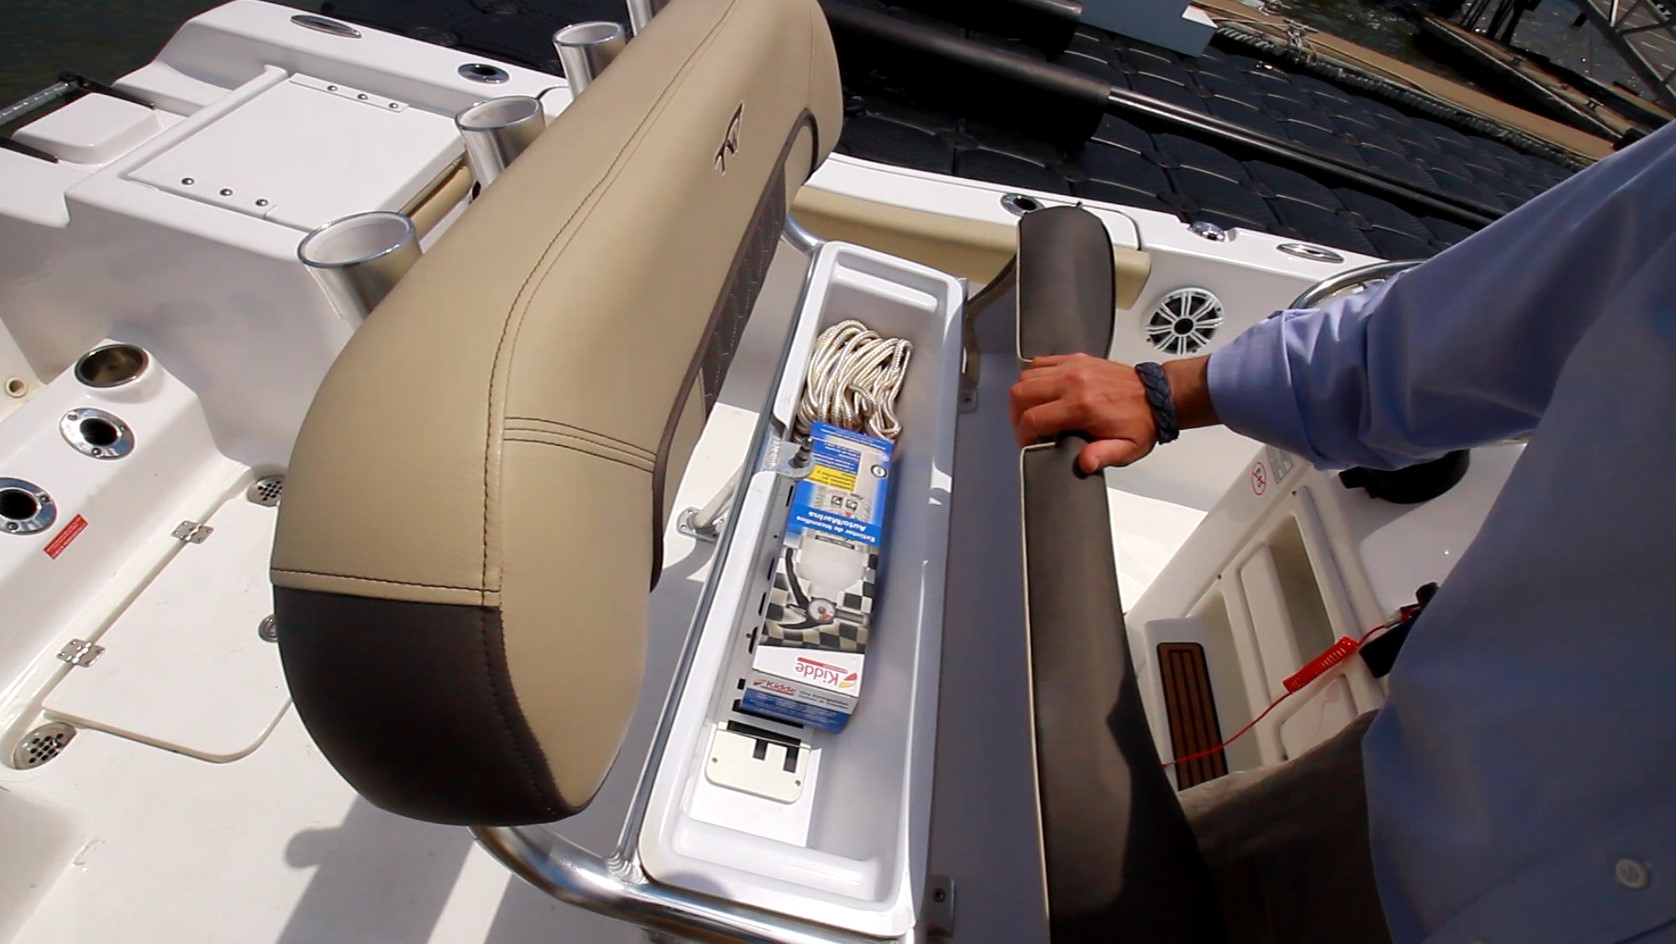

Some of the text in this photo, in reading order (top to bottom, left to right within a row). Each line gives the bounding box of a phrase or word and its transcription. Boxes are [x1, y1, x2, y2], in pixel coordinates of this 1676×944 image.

[796, 515, 833, 531] Incendios
[808, 511, 867, 532] Auto/Marina
[833, 525, 844, 533] de
[844, 529, 876, 543] Extintor
[795, 662, 840, 686] Kidde
[766, 680, 797, 695] Kidde
